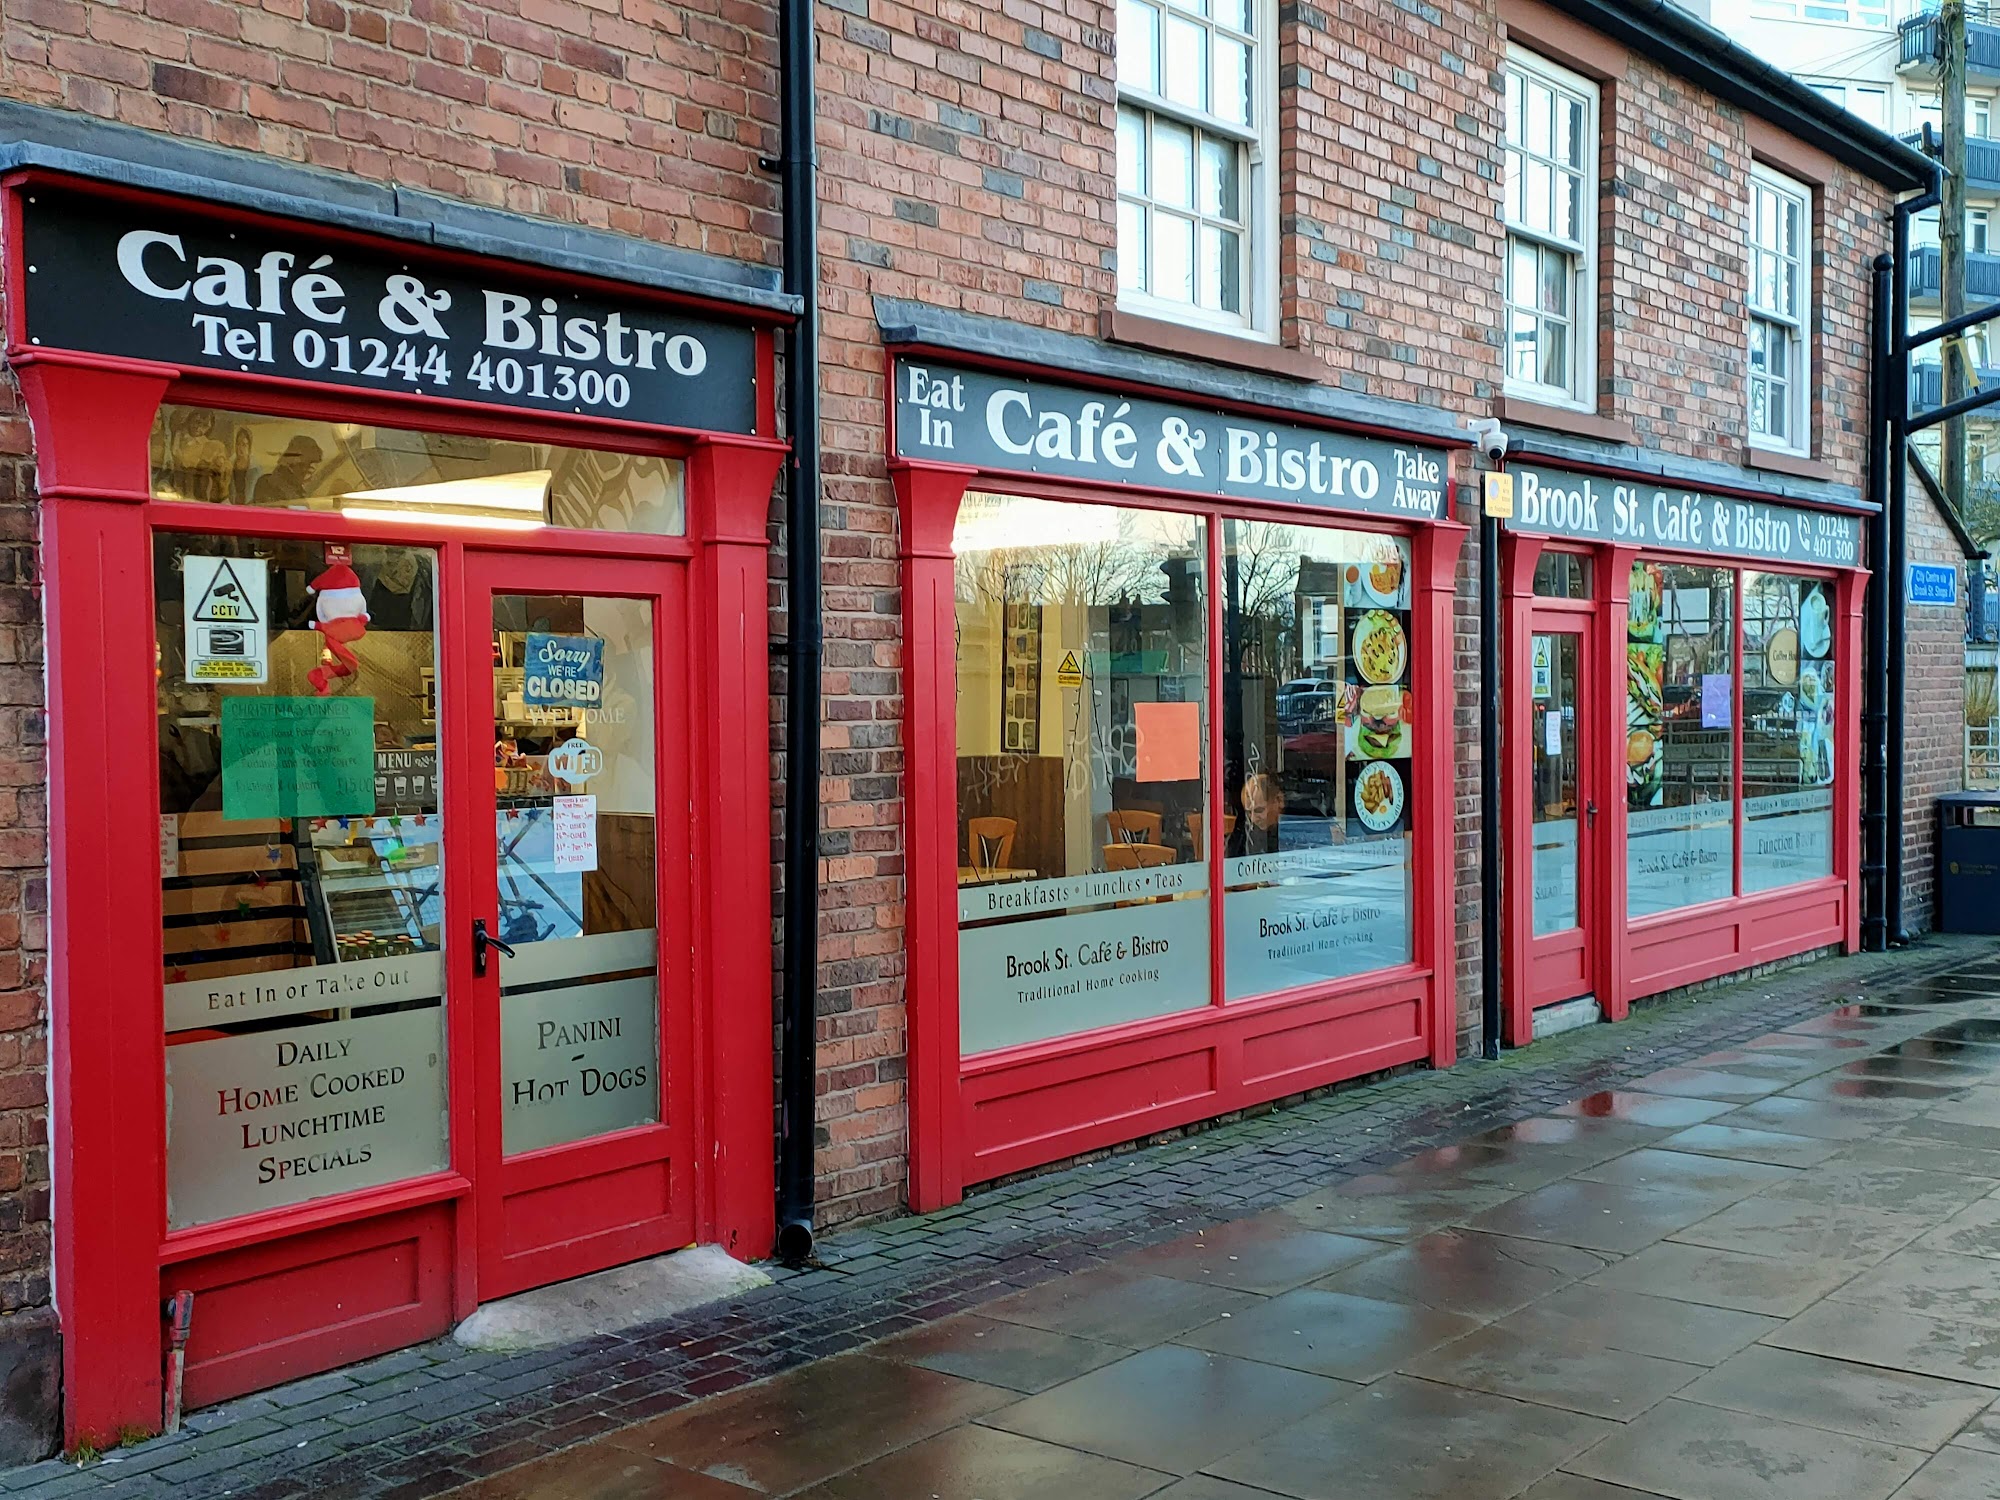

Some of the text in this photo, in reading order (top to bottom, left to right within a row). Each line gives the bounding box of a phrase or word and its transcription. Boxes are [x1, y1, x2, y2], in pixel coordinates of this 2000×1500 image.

[116, 229, 707, 376] Café & Bistro
[191, 313, 630, 408] Tel 01244 401300
[908, 366, 1440, 500] Eat Café & Bistro Take
[919, 409, 1441, 520] In Away
[1520, 471, 1599, 532] Brook
[1613, 485, 1645, 538] St.
[1652, 492, 1702, 544] Café
[1711, 501, 1730, 547] &
[1735, 504, 1791, 554] Bistro
[1819, 515, 1850, 539] 01244
[1813, 534, 1854, 561] 401 300
[211, 604, 240, 616] CCTV
[539, 640, 590, 672] Sorry
[547, 664, 577, 677] WE'RE
[527, 676, 600, 701] CLOSED
[307, 703, 349, 716] DINNER
[378, 752, 412, 769] MENU
[1758, 834, 1793, 854] Function
[988, 873, 1182, 910] Breakfasts Lunches Teas
[1535, 885, 1563, 900] SALAD
[1259, 914, 1292, 938] Brook
[1312, 907, 1338, 928] Café
[1352, 906, 1381, 922] Bistro
[1006, 935, 1169, 978] Brook St. Café & Bistro
[1268, 941, 1314, 960] Traditional
[1318, 939, 1340, 950] Home
[208, 969, 410, 1010] Eat In or Take Out
[1018, 968, 1159, 1003] Traditional Home Cooking
[537, 1016, 622, 1050] PANINI
[276, 1037, 353, 1067] DAILY
[217, 1066, 406, 1116] HOME COOKED
[580, 1065, 647, 1097] DOGS
[242, 1104, 386, 1150] LUNCHTIME
[258, 1143, 373, 1184] SPECIALS
